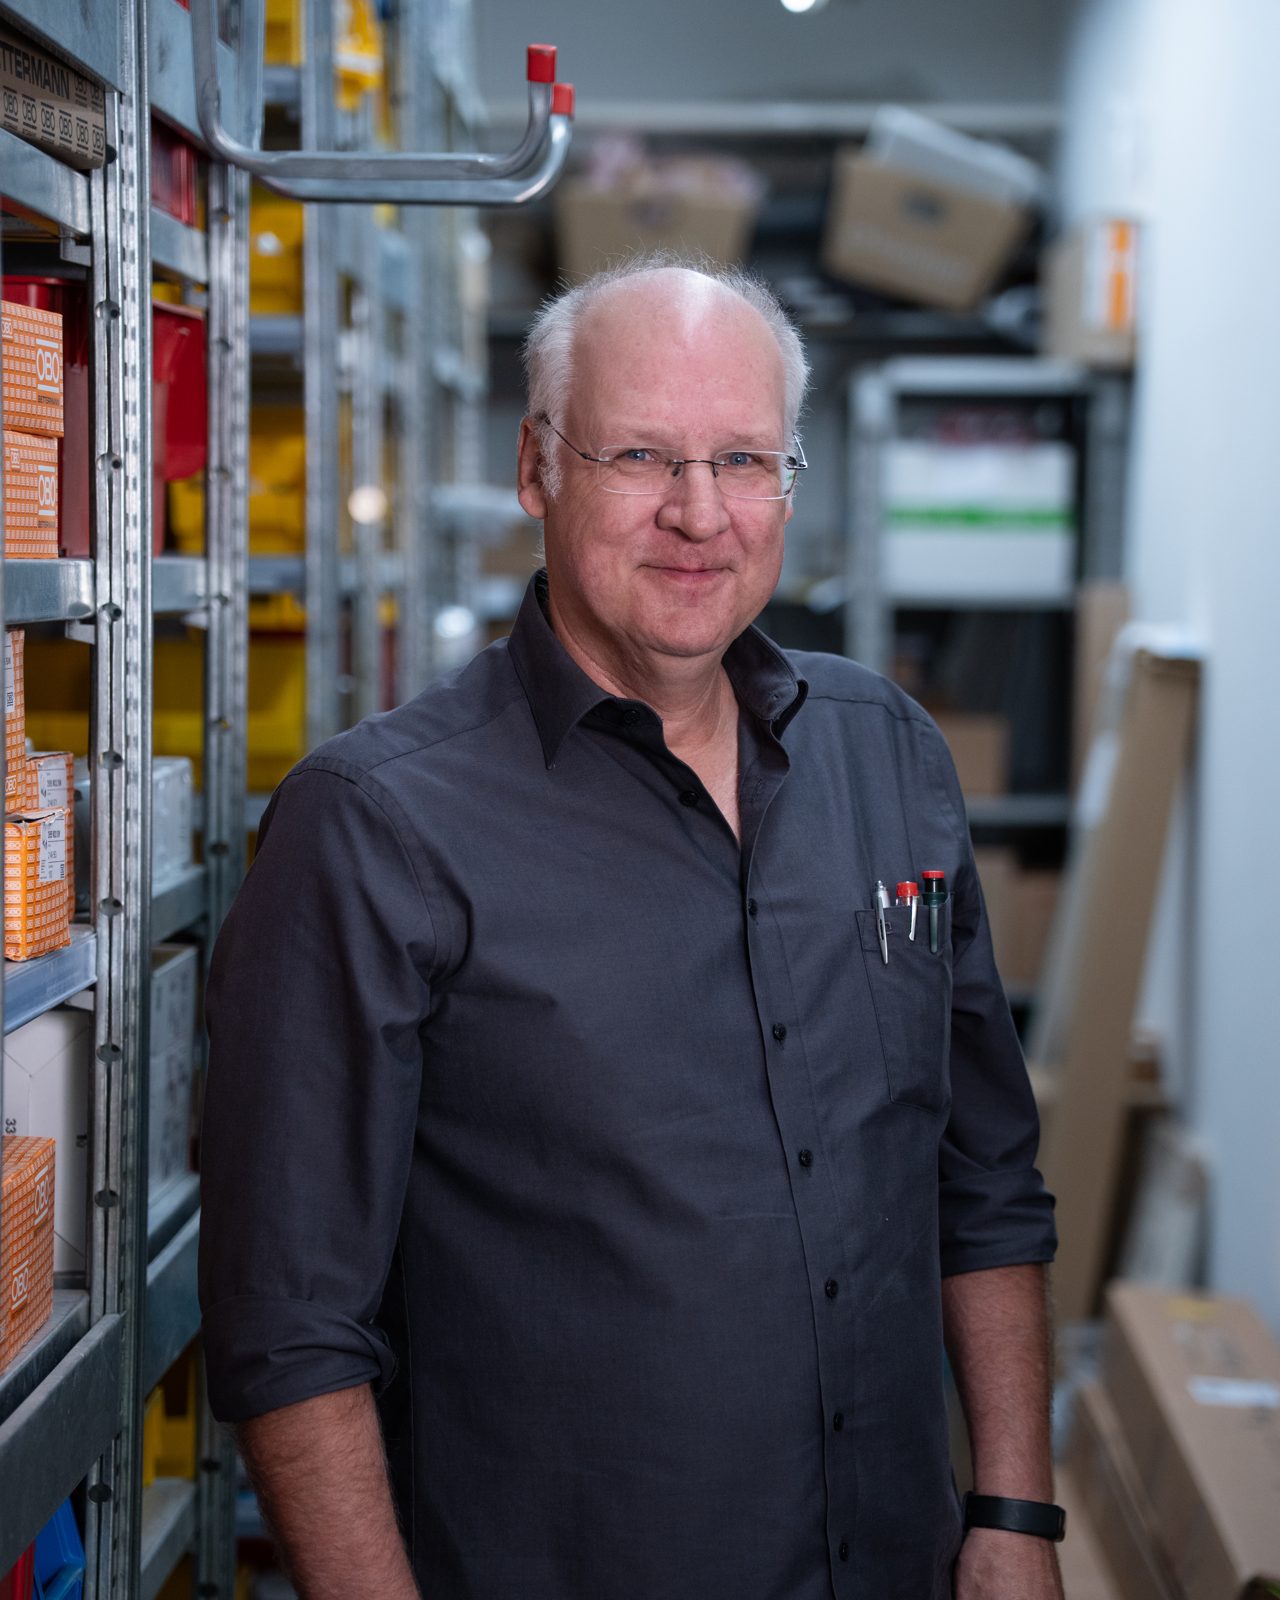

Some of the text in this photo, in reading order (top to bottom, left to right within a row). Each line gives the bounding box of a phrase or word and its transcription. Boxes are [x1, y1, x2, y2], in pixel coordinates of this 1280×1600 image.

[3, 92, 18, 116] OBO
[22, 101, 37, 124] OBO
[41, 108, 55, 131] OBO
[59, 115, 73, 139] OBO
[76, 121, 89, 145] OBO
[92, 128, 104, 151] OBO
[36, 348, 60, 384] OBO
[38, 474, 56, 506] OBO
[5, 1118, 16, 1134] 33
[34, 1175, 50, 1215] OBO
[11, 1267, 29, 1301] OBO
